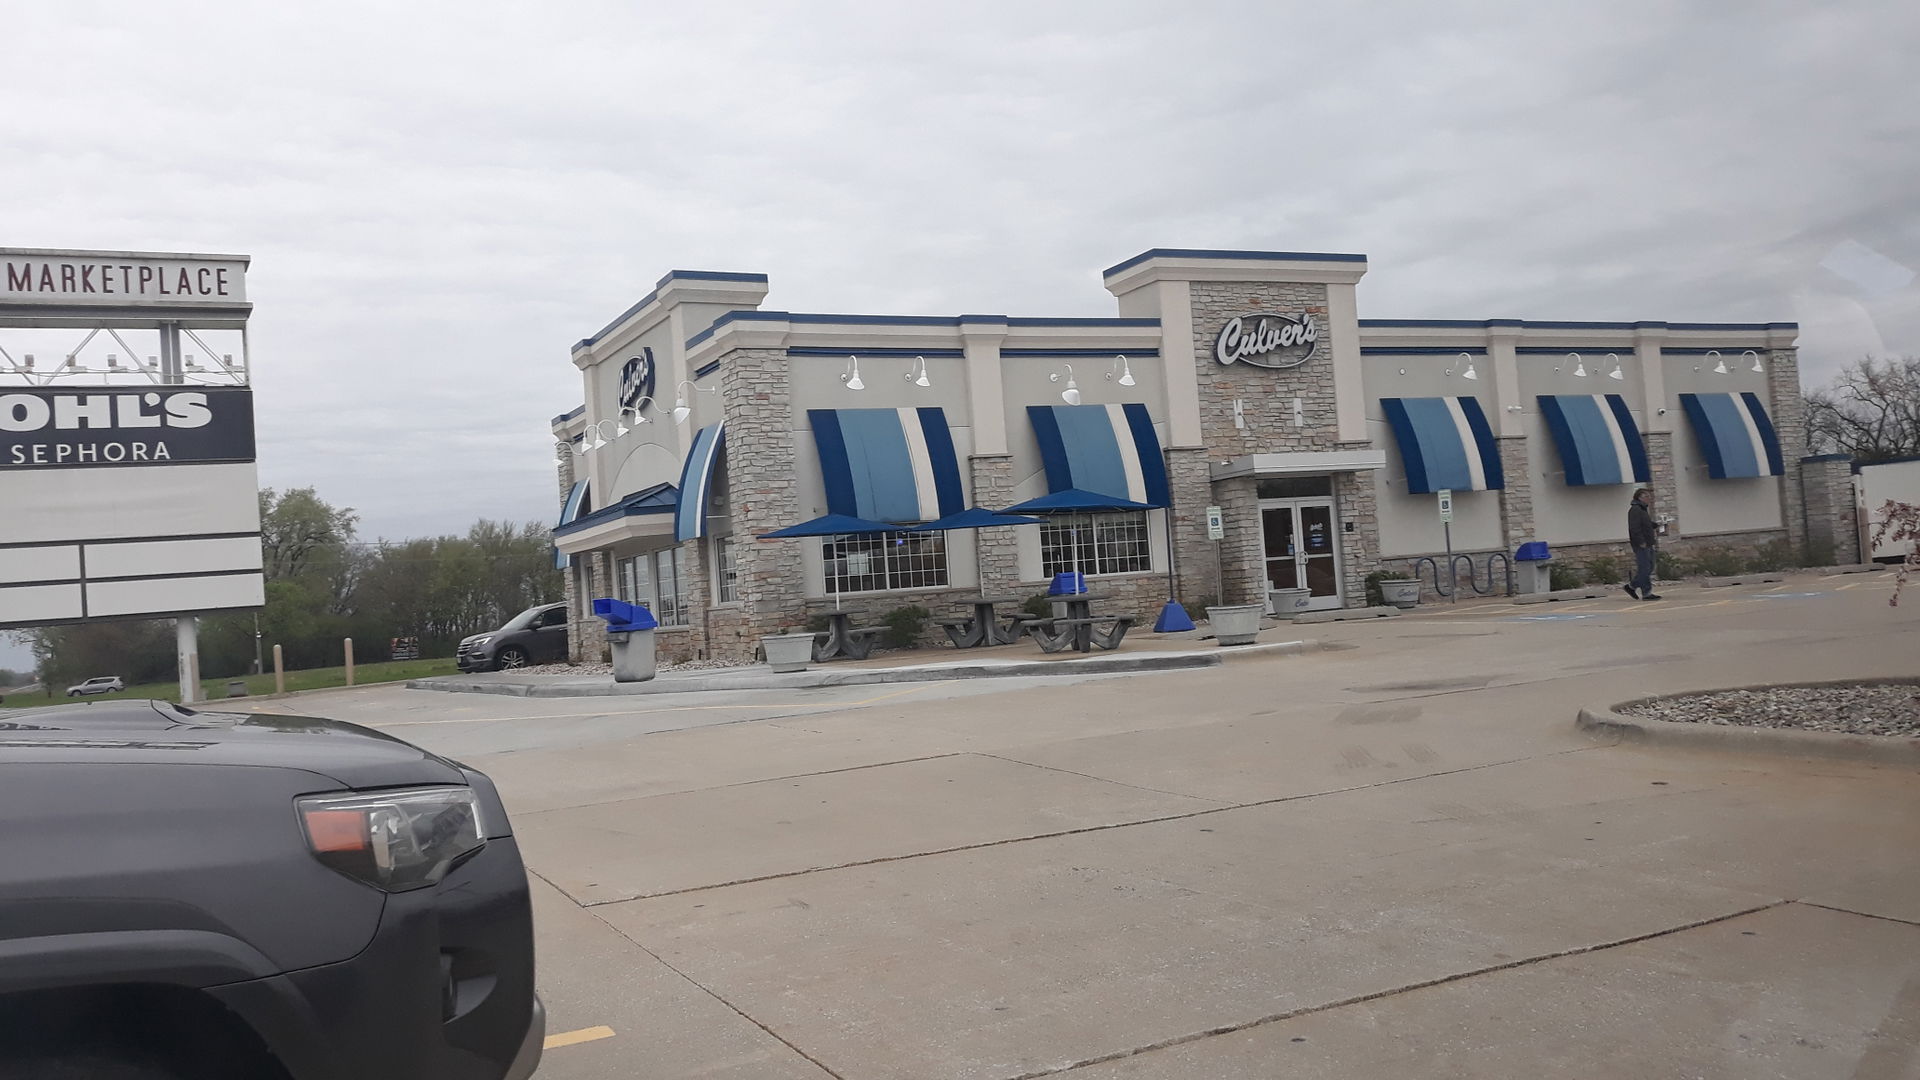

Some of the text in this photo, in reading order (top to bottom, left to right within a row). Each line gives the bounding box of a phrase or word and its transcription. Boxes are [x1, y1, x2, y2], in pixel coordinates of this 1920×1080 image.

[7, 262, 228, 295] MARKETPLACE
[1217, 314, 1317, 365] Culver's
[0, 393, 212, 431] OHL'S
[11, 442, 170, 463] SEPHORA
